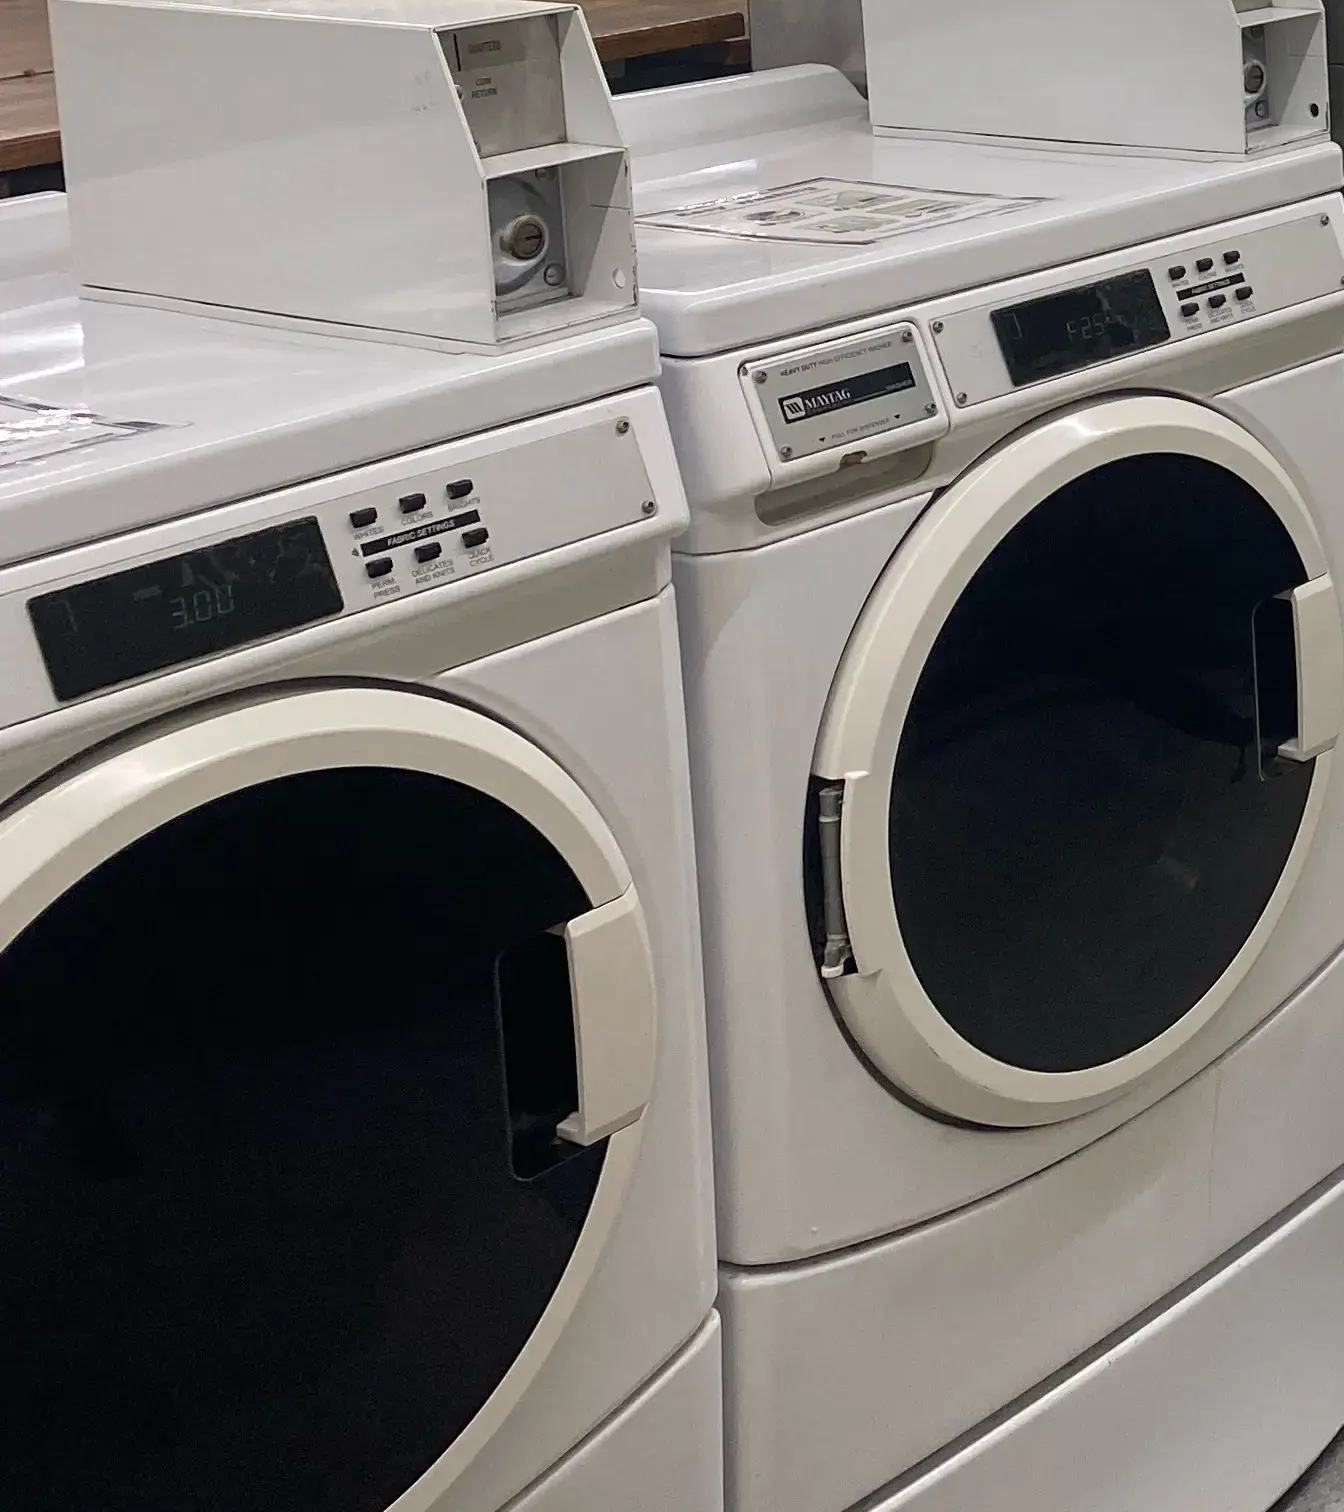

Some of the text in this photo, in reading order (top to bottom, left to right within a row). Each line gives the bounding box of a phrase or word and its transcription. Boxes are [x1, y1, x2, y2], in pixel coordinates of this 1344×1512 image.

[780, 366, 801, 377] HEAVY
[801, 361, 818, 372] DUTY
[833, 349, 867, 363] EFFICIENCY
[804, 388, 851, 410] MAYTAG
[447, 496, 481, 511] BRIGHTS
[400, 511, 434, 526] COLORS
[353, 526, 385, 540] WHITES
[387, 519, 456, 547] FABRIC SETTINGS
[411, 559, 454, 578] DELICATES
[470, 555, 495, 567] CYCLE
[415, 567, 456, 585] AND KNITS
[373, 585, 401, 600] PRESS
